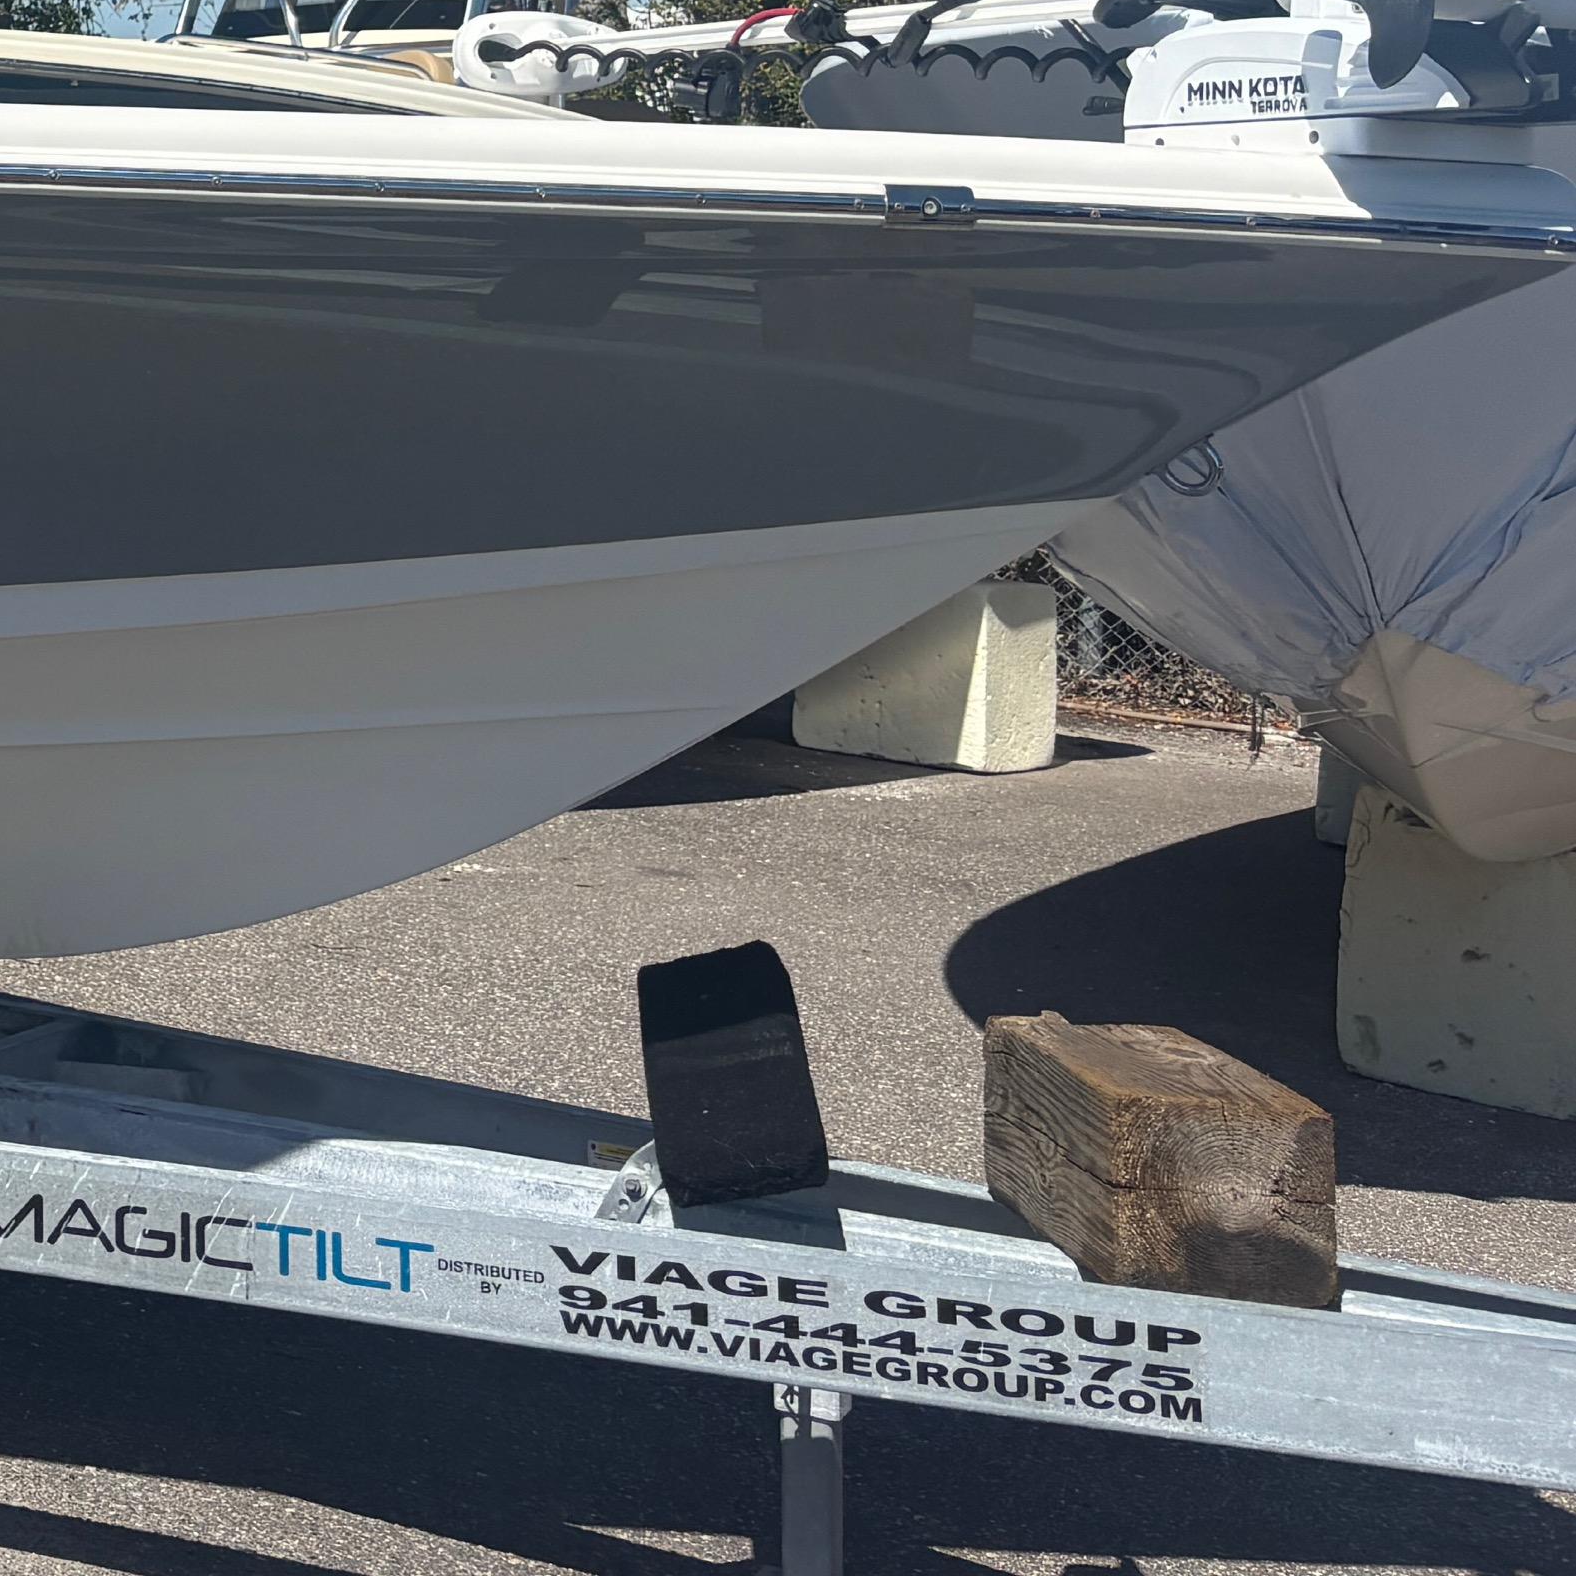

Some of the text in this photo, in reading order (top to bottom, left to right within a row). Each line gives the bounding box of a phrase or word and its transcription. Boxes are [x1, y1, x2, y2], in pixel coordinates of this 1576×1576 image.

[1187, 75, 1306, 102] MINN KOTA
[1250, 98, 1308, 114] TERROVA
[437, 1258, 545, 1284] DISTRIBUTED
[480, 1281, 502, 1295] BY
[549, 1245, 1202, 1353] VIAGE GROUP
[558, 1285, 1194, 1392] 941-444-5375
[560, 1310, 1202, 1423] WWW.VIAGEGROUP.COM
